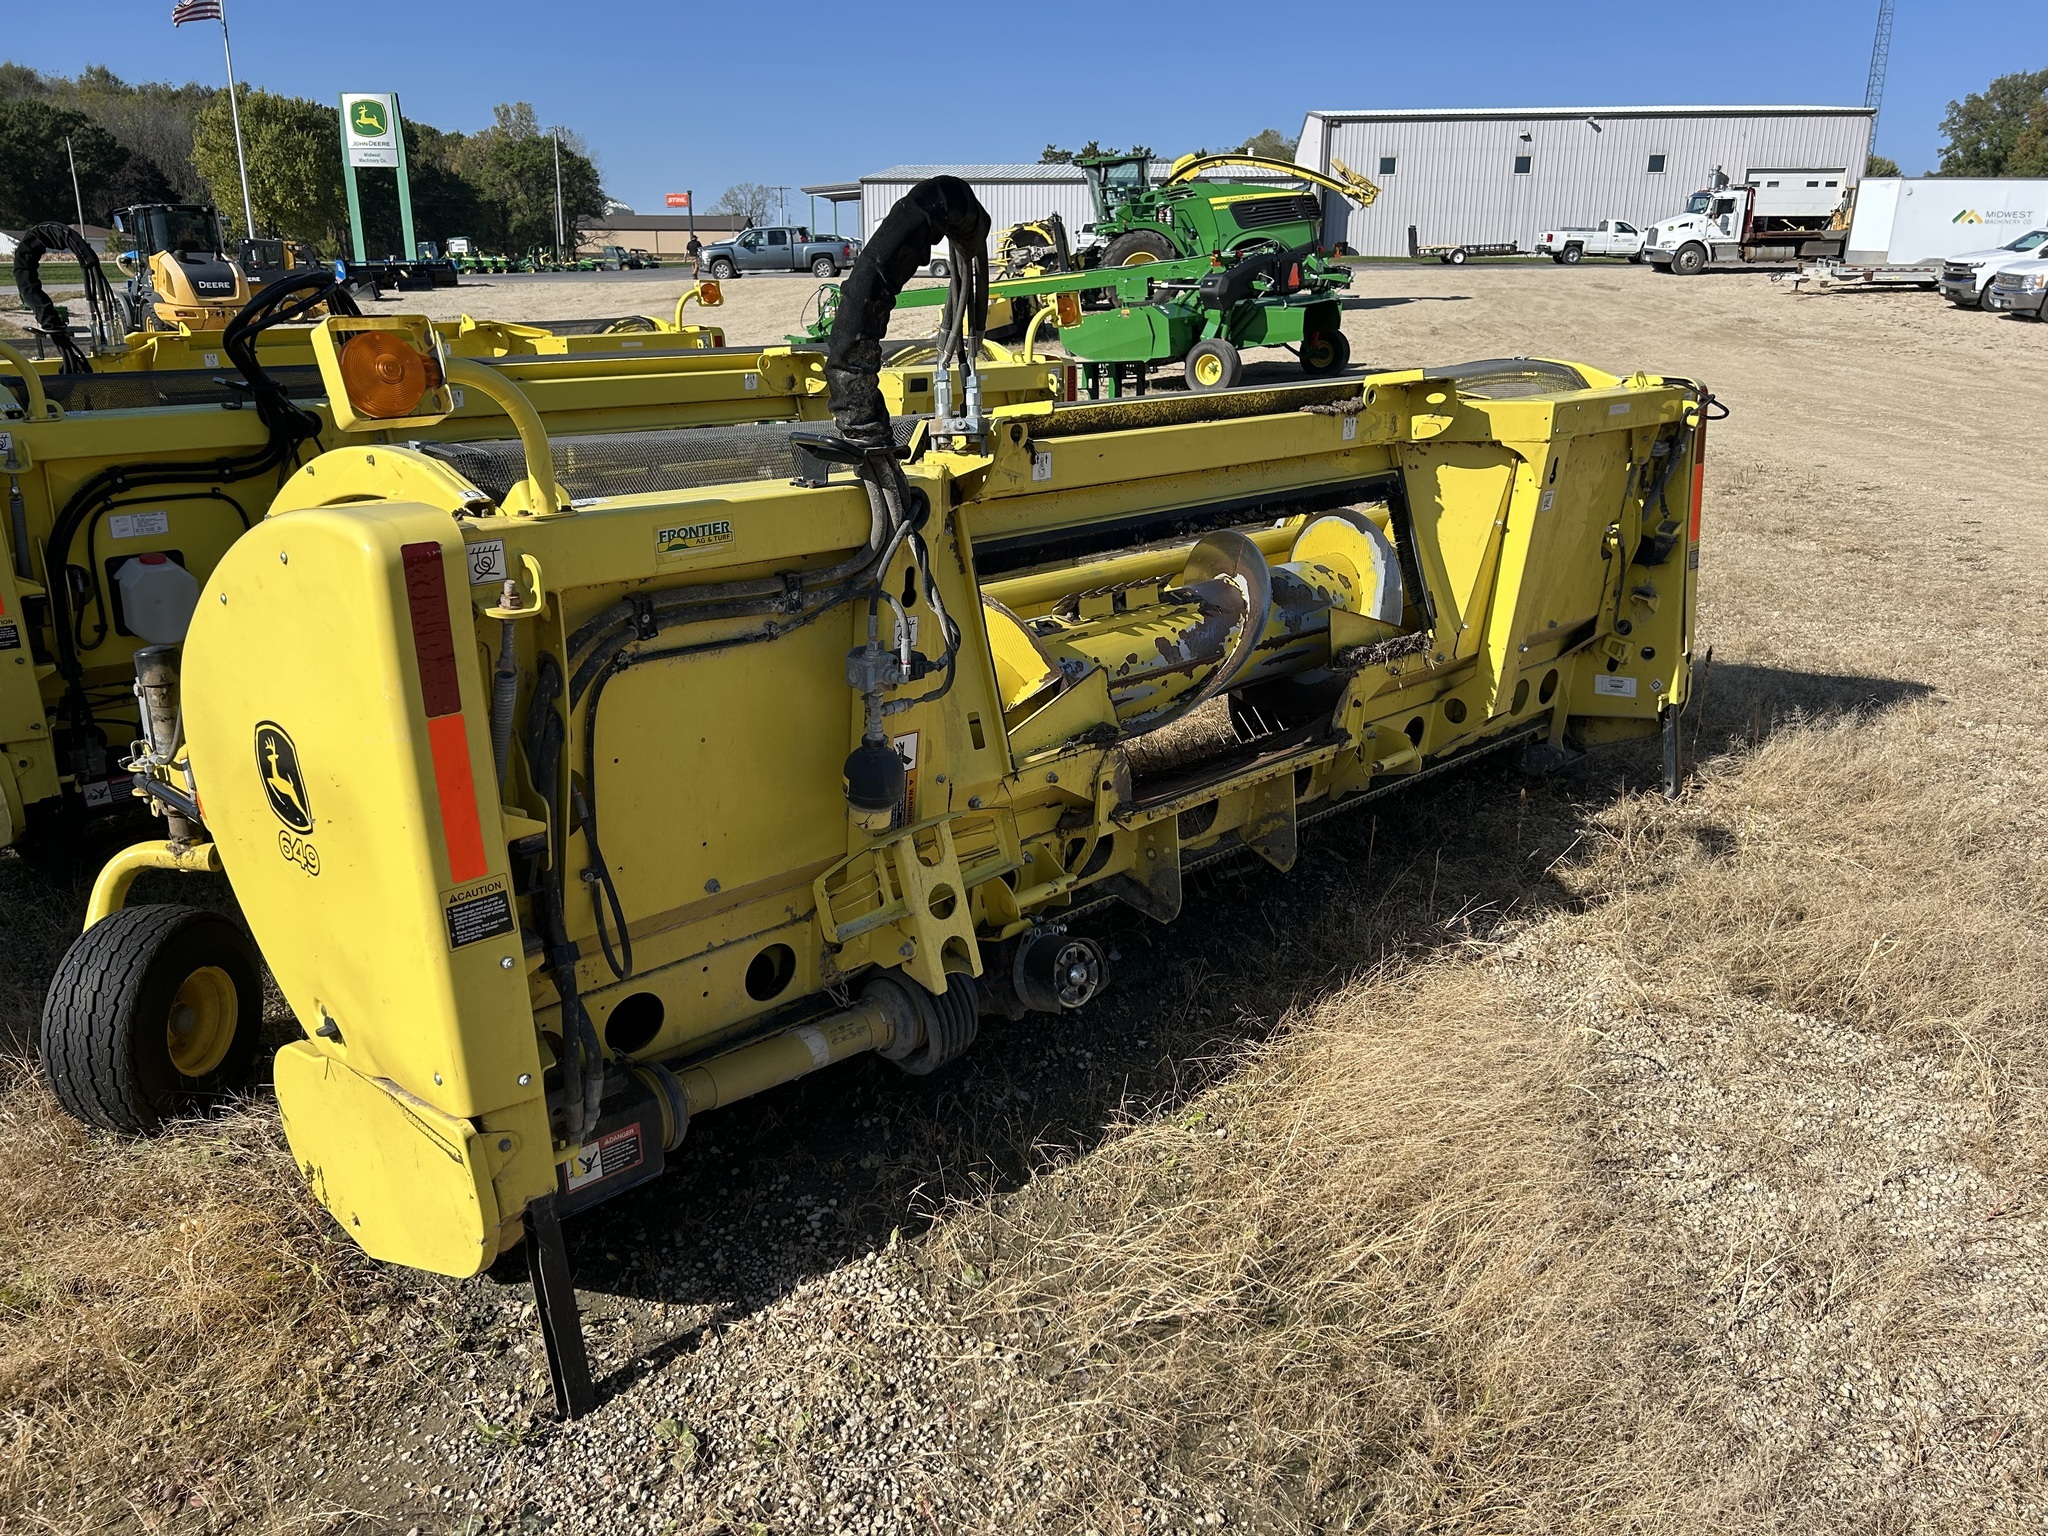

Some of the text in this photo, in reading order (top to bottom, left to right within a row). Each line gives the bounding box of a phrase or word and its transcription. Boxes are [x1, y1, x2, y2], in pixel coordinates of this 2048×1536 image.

[1986, 210, 2034, 218] MIDWEST
[198, 281, 231, 289] DEERE
[658, 520, 730, 543] FRONTIER
[714, 534, 730, 542] TURF
[278, 830, 320, 876] 649
[458, 881, 501, 900] CAUTION
[608, 1128, 634, 1142] DANGER
